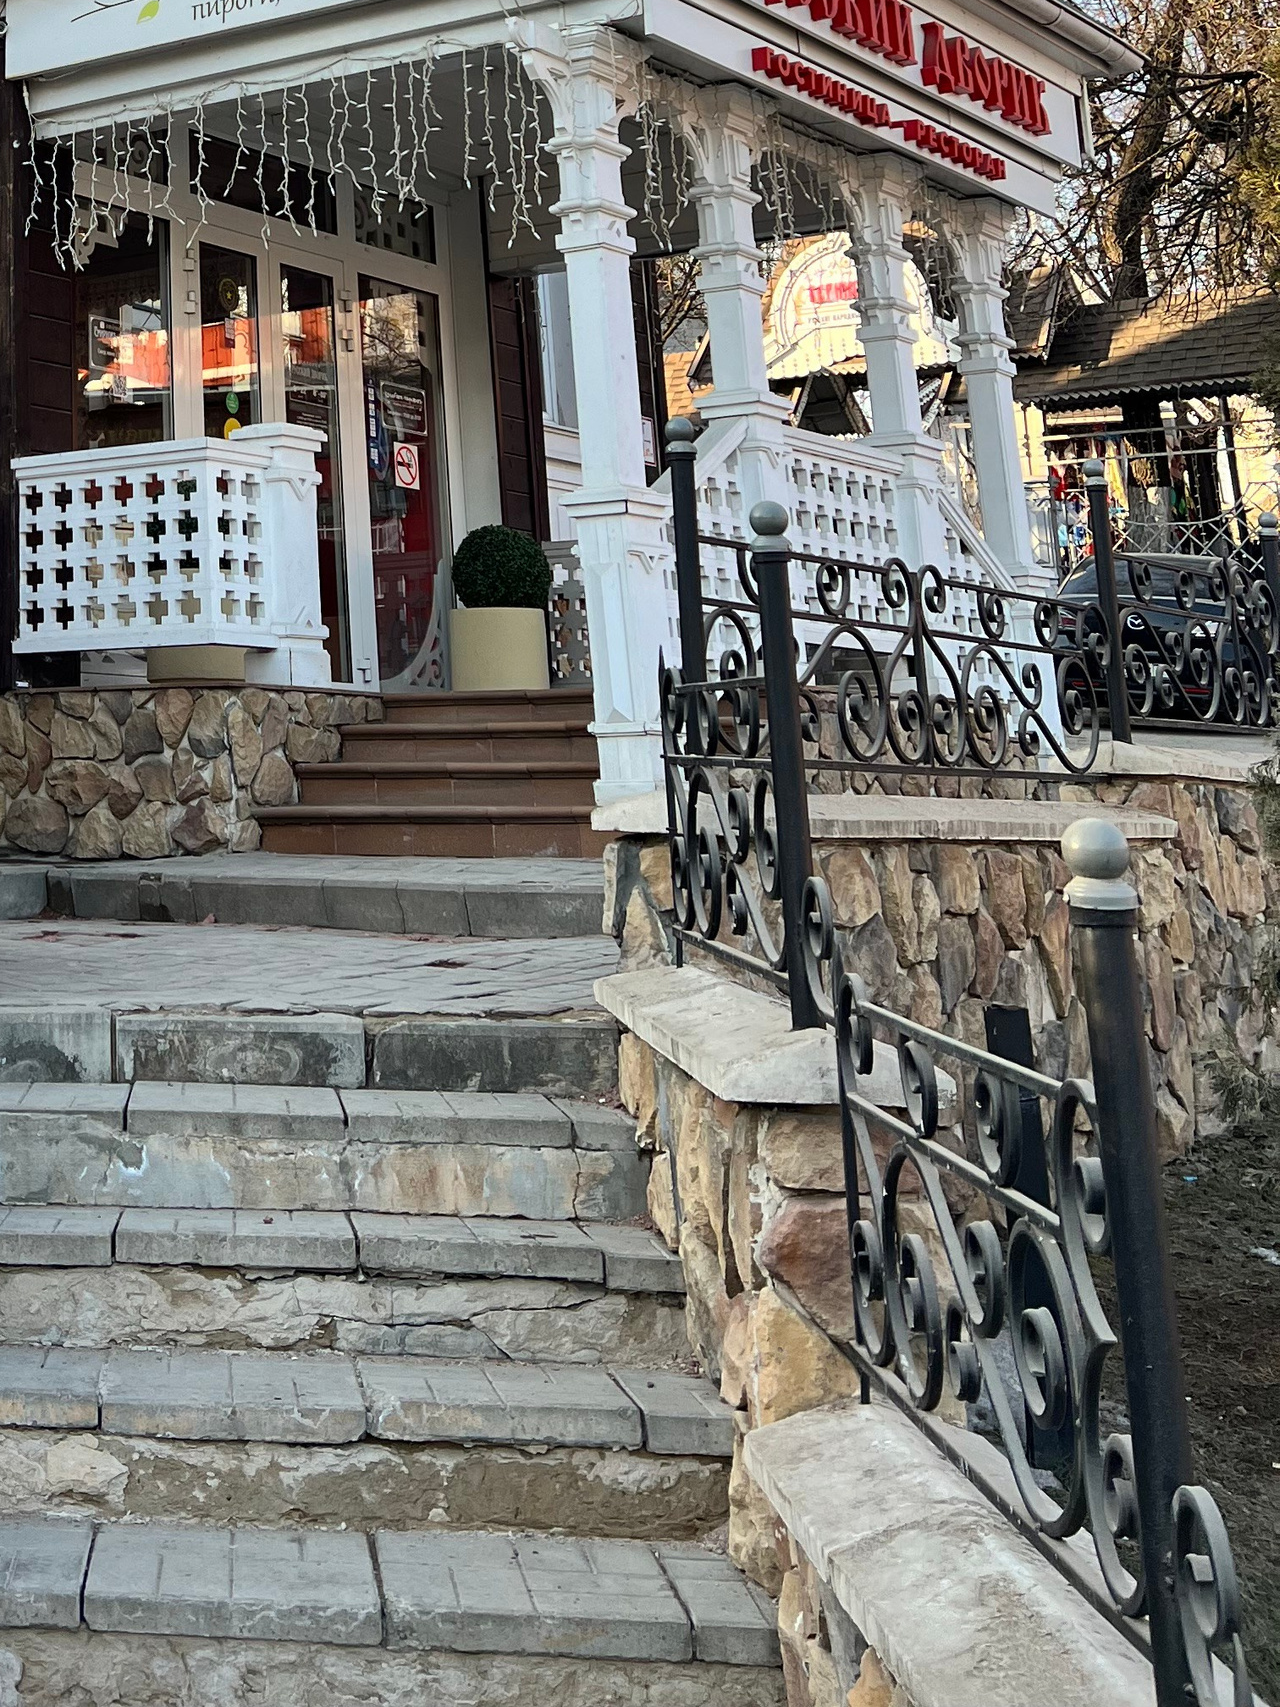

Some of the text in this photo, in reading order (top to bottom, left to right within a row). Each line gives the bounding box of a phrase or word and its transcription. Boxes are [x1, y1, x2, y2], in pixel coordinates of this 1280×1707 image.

[751, 46, 892, 129] ГОСТИНИЦА
[903, 119, 1007, 181] РЕСТОРАН
[920, 21, 1053, 137] ДВОРИК
